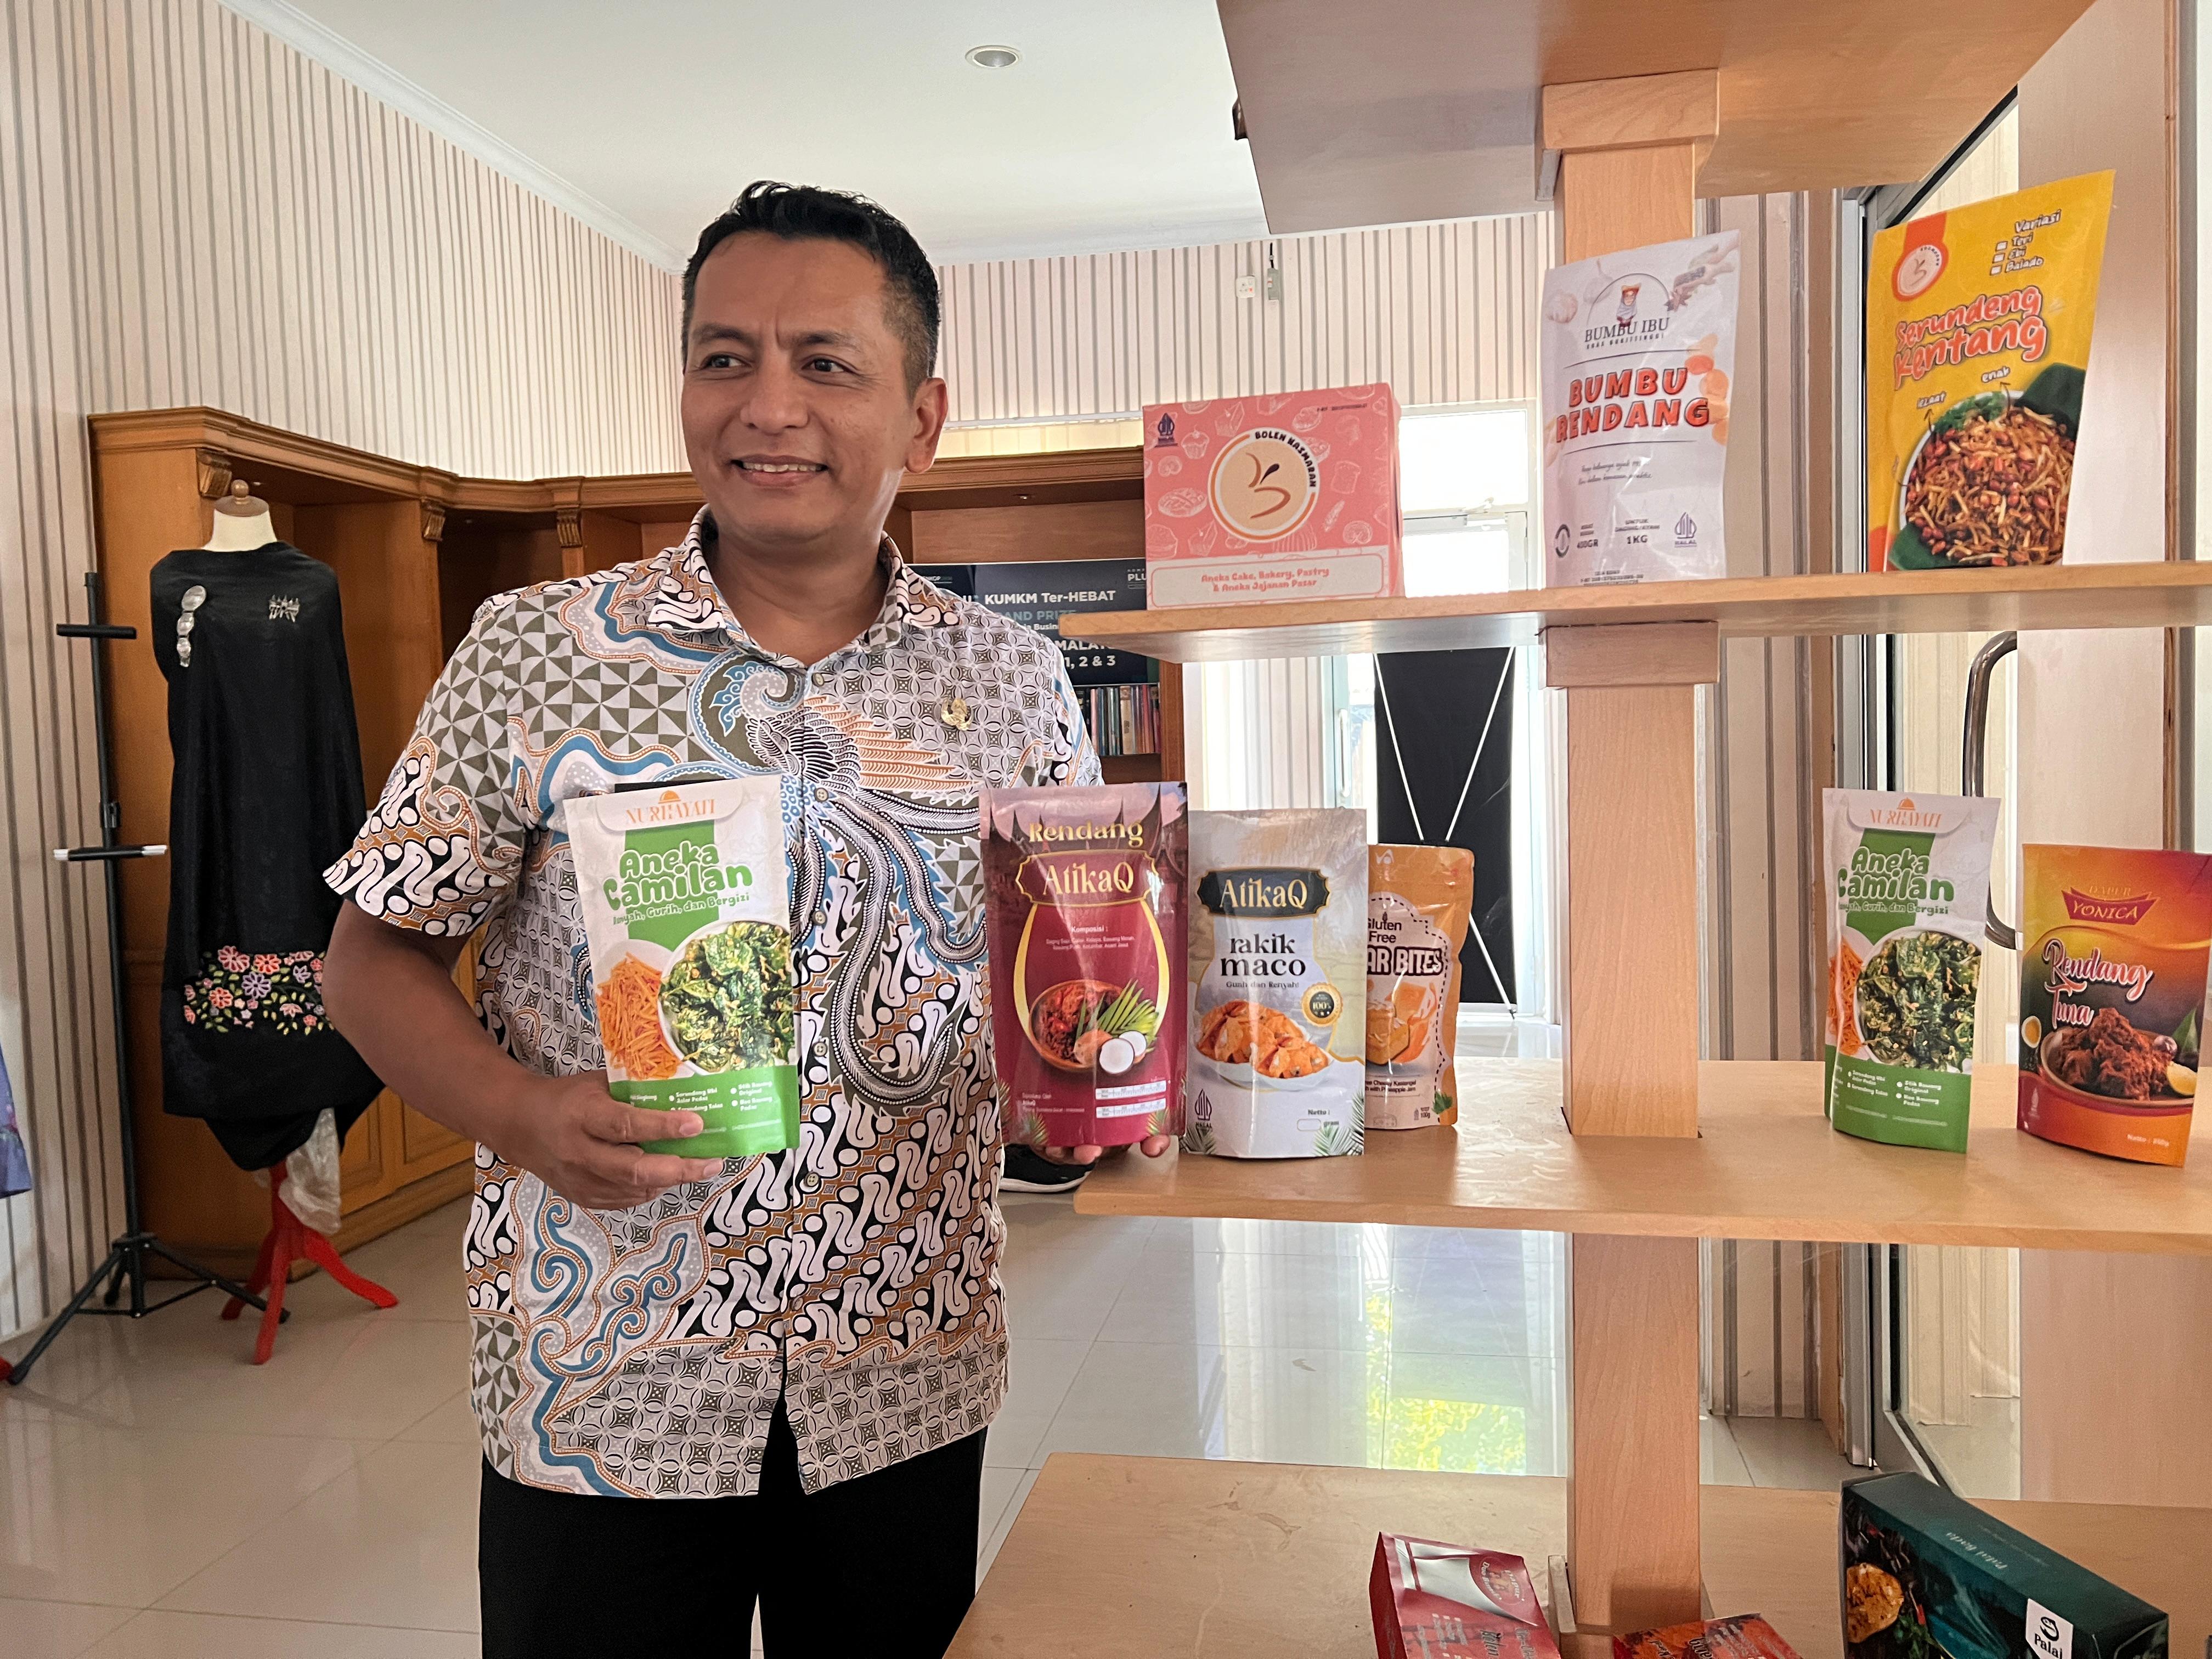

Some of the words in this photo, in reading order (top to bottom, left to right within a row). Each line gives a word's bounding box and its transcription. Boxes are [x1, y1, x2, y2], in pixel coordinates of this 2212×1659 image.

[1585, 321, 1638, 342] BUMBU
[1641, 318, 1670, 332] IBU
[1896, 285, 2042, 351] Serundeng
[1894, 315, 2046, 391] Kentang
[1568, 368, 1688, 408] BUMBU
[1556, 397, 1709, 443] RENDANG
[1296, 567, 1329, 578] Pastry
[985, 593, 1037, 605] KUMKM
[1041, 590, 1116, 603] Ter-HEBAT
[1079, 656, 1088, 667] 2
[1092, 656, 1102, 667] &
[1107, 655, 1116, 665] 3
[1029, 820, 1143, 848] Rendang
[619, 840, 719, 879] Aneka
[1852, 846, 1930, 875] Aneka
[603, 862, 753, 911] Camilan
[1043, 862, 1133, 895] AtikaQ
[646, 904, 682, 918] Gurih,
[684, 900, 706, 912] dan
[707, 892, 749, 908] Bergizi
[1220, 877, 1307, 909] AtikaQ
[1907, 902, 1948, 916] Bergizi
[2073, 900, 2138, 919] YONICA
[1230, 933, 1295, 954] rakik
[1369, 931, 1397, 943] Free
[1220, 957, 1306, 977] maco
[1367, 945, 1391, 975] AR
[1394, 946, 1443, 976] BITES
[2043, 938, 2153, 1002] Rendang
[2044, 980, 2095, 1030] Tuna
[2034, 1633, 2063, 1659] Palai
